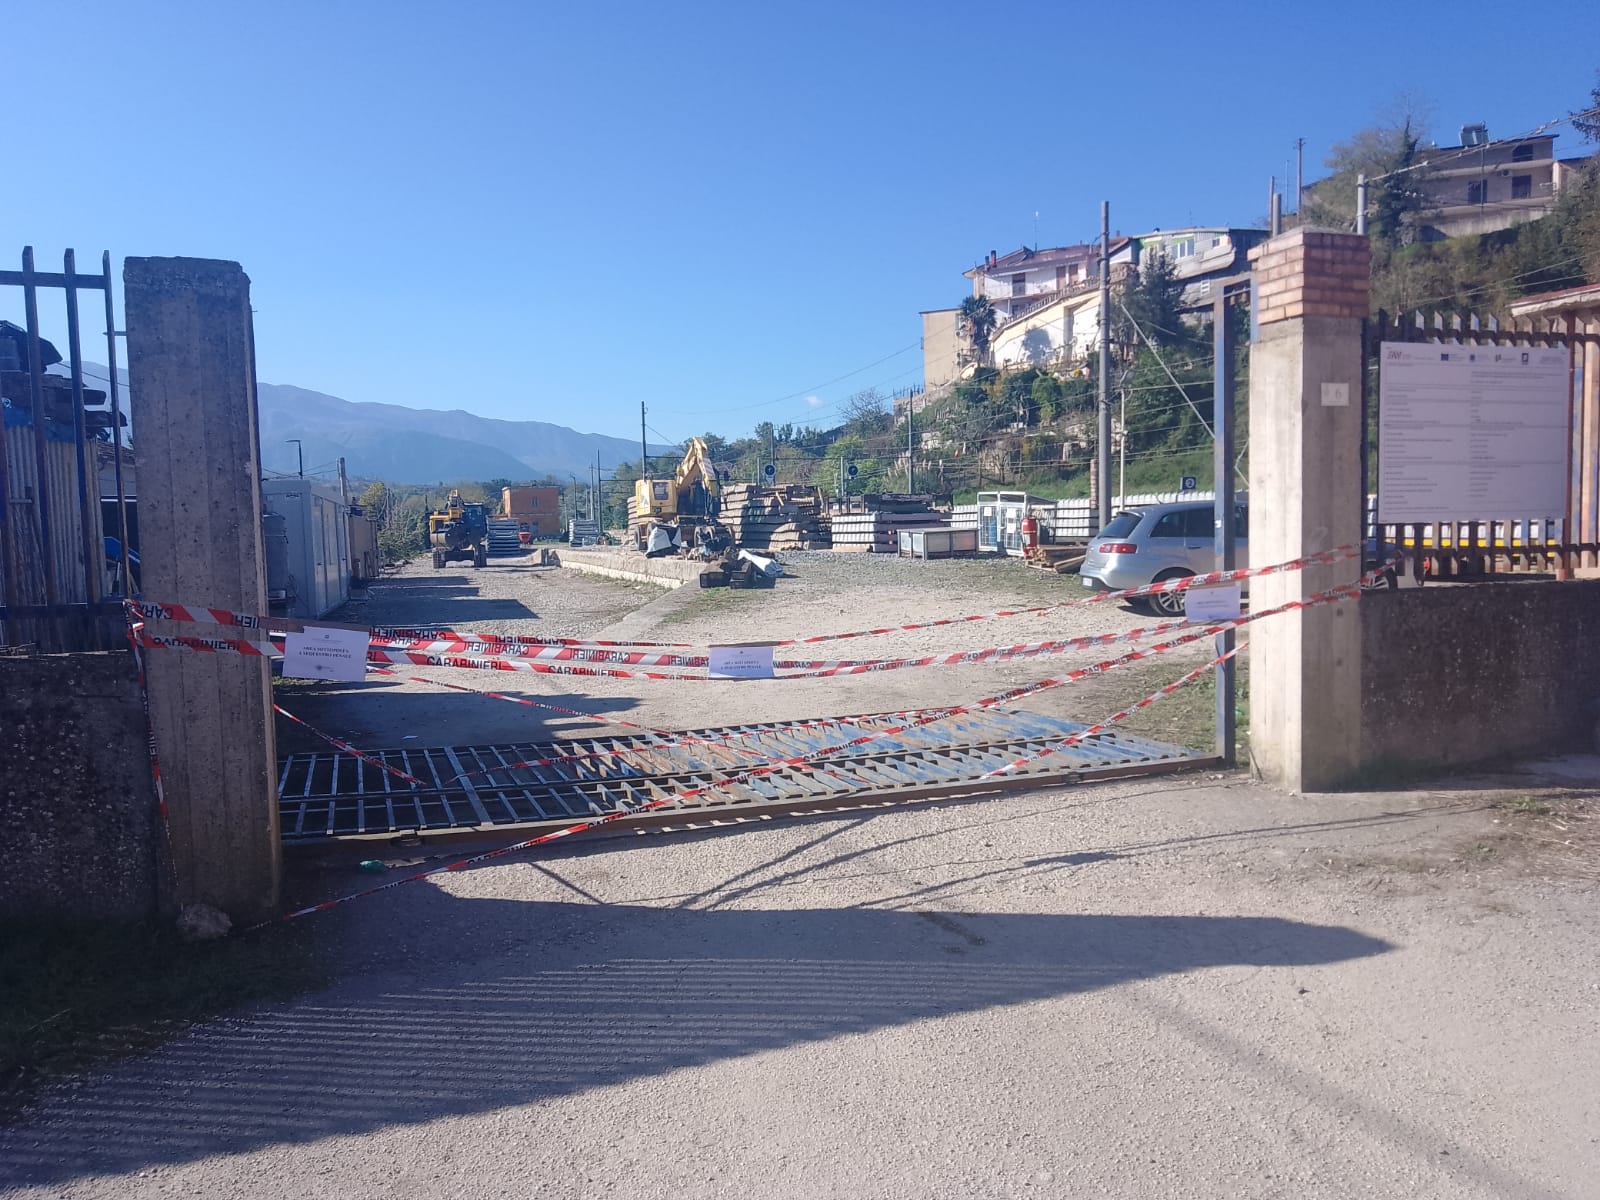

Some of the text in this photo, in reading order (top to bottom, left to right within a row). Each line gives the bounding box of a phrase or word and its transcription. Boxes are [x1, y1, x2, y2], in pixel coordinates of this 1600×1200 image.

[153, 637, 240, 650] CARABINIERI
[426, 656, 504, 670] CARABINIERI
[548, 666, 618, 678] CARABINIERI
